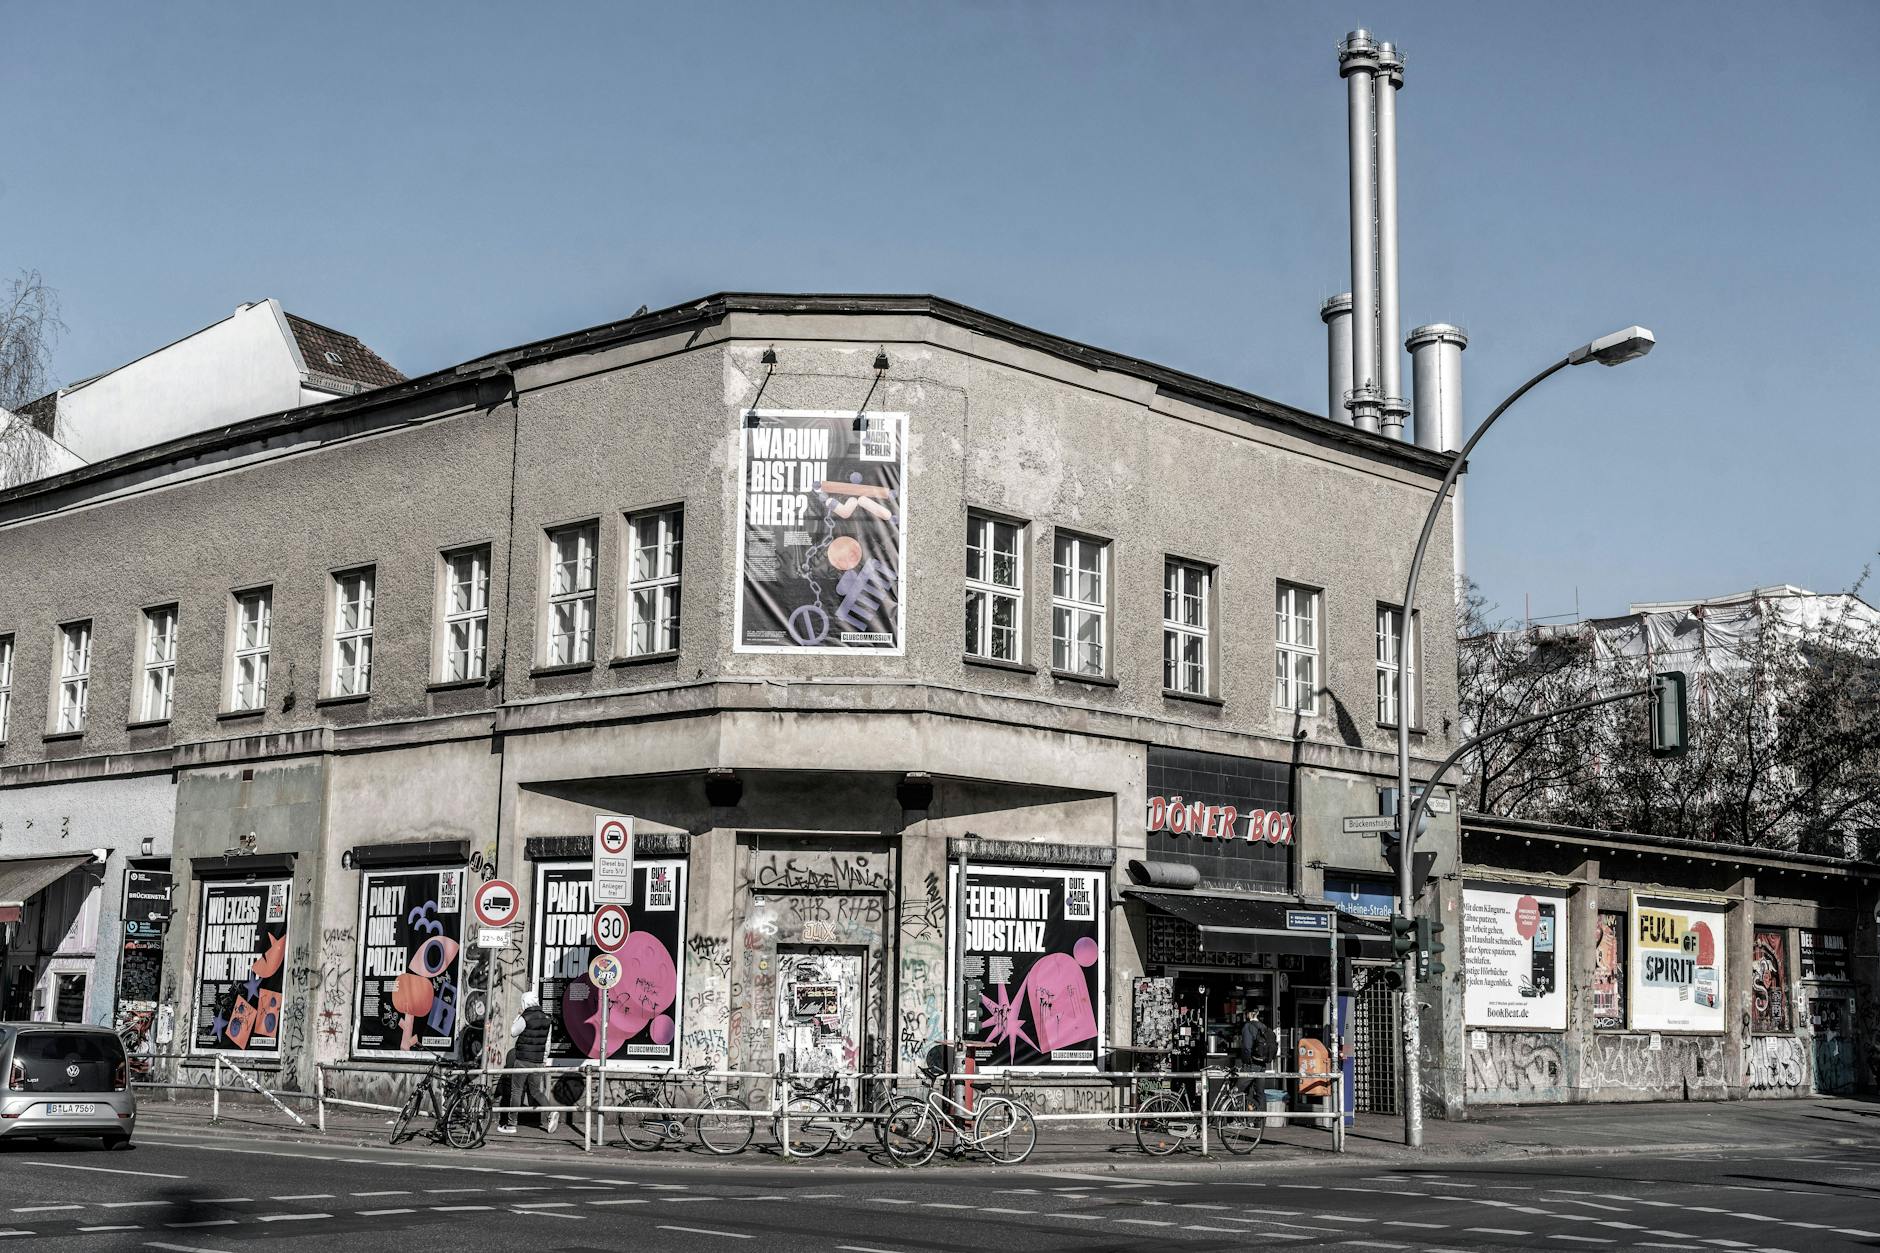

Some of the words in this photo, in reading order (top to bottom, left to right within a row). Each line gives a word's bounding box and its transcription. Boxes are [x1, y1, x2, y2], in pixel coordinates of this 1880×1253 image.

[867, 419, 885, 430] UTE
[752, 428, 829, 459] WARUM
[866, 444, 891, 456] BERLIN
[751, 461, 797, 492] BIST
[800, 461, 827, 493] DU
[750, 494, 808, 526] HIER?
[842, 633, 892, 642] CLUBCOMMISSION
[1148, 796, 1237, 839] DÖNER
[1247, 809, 1297, 845] BOX
[1349, 819, 1391, 828] Brückenstraße
[651, 868, 666, 880] GUTE
[1069, 878, 1084, 889] GUTE
[129, 892, 166, 900] BRÜCKENSTR.
[165, 887, 170, 900] 1
[547, 881, 595, 912] PARTY
[650, 893, 672, 906] BERLIN
[1069, 891, 1091, 903] NACHT,
[1351, 883, 1359, 901] U
[370, 886, 406, 915] PARTY
[1019, 888, 1050, 920] MIT
[1472, 903, 1484, 912] dem
[208, 897, 225, 924] WO
[225, 896, 260, 923] EXZESS
[1069, 903, 1090, 915] BERLIN
[1335, 902, 1392, 917] ch-Heine-Straße
[368, 917, 397, 945] OHNE
[546, 914, 596, 945] UTOPI
[601, 917, 621, 938] 30
[1472, 925, 1487, 933] Arbeit
[1640, 915, 1679, 944] FULL
[205, 925, 225, 952] AUF
[224, 925, 260, 952] NACHT-
[1472, 935, 1495, 944] Haushalt
[1683, 935, 1696, 952] OF
[1478, 946, 1491, 956] Spree
[203, 953, 229, 981] RUHE
[365, 947, 407, 976] POLIZEI
[544, 947, 590, 978] BLICK
[1465, 966, 1480, 977] ustige
[1646, 956, 1695, 984] SPIRIT
[1487, 1007, 1529, 1018] BookBeat.de
[628, 1045, 669, 1053] CLUBCOMMISSION
[1053, 1051, 1093, 1060] CLUBCOMMISSION
